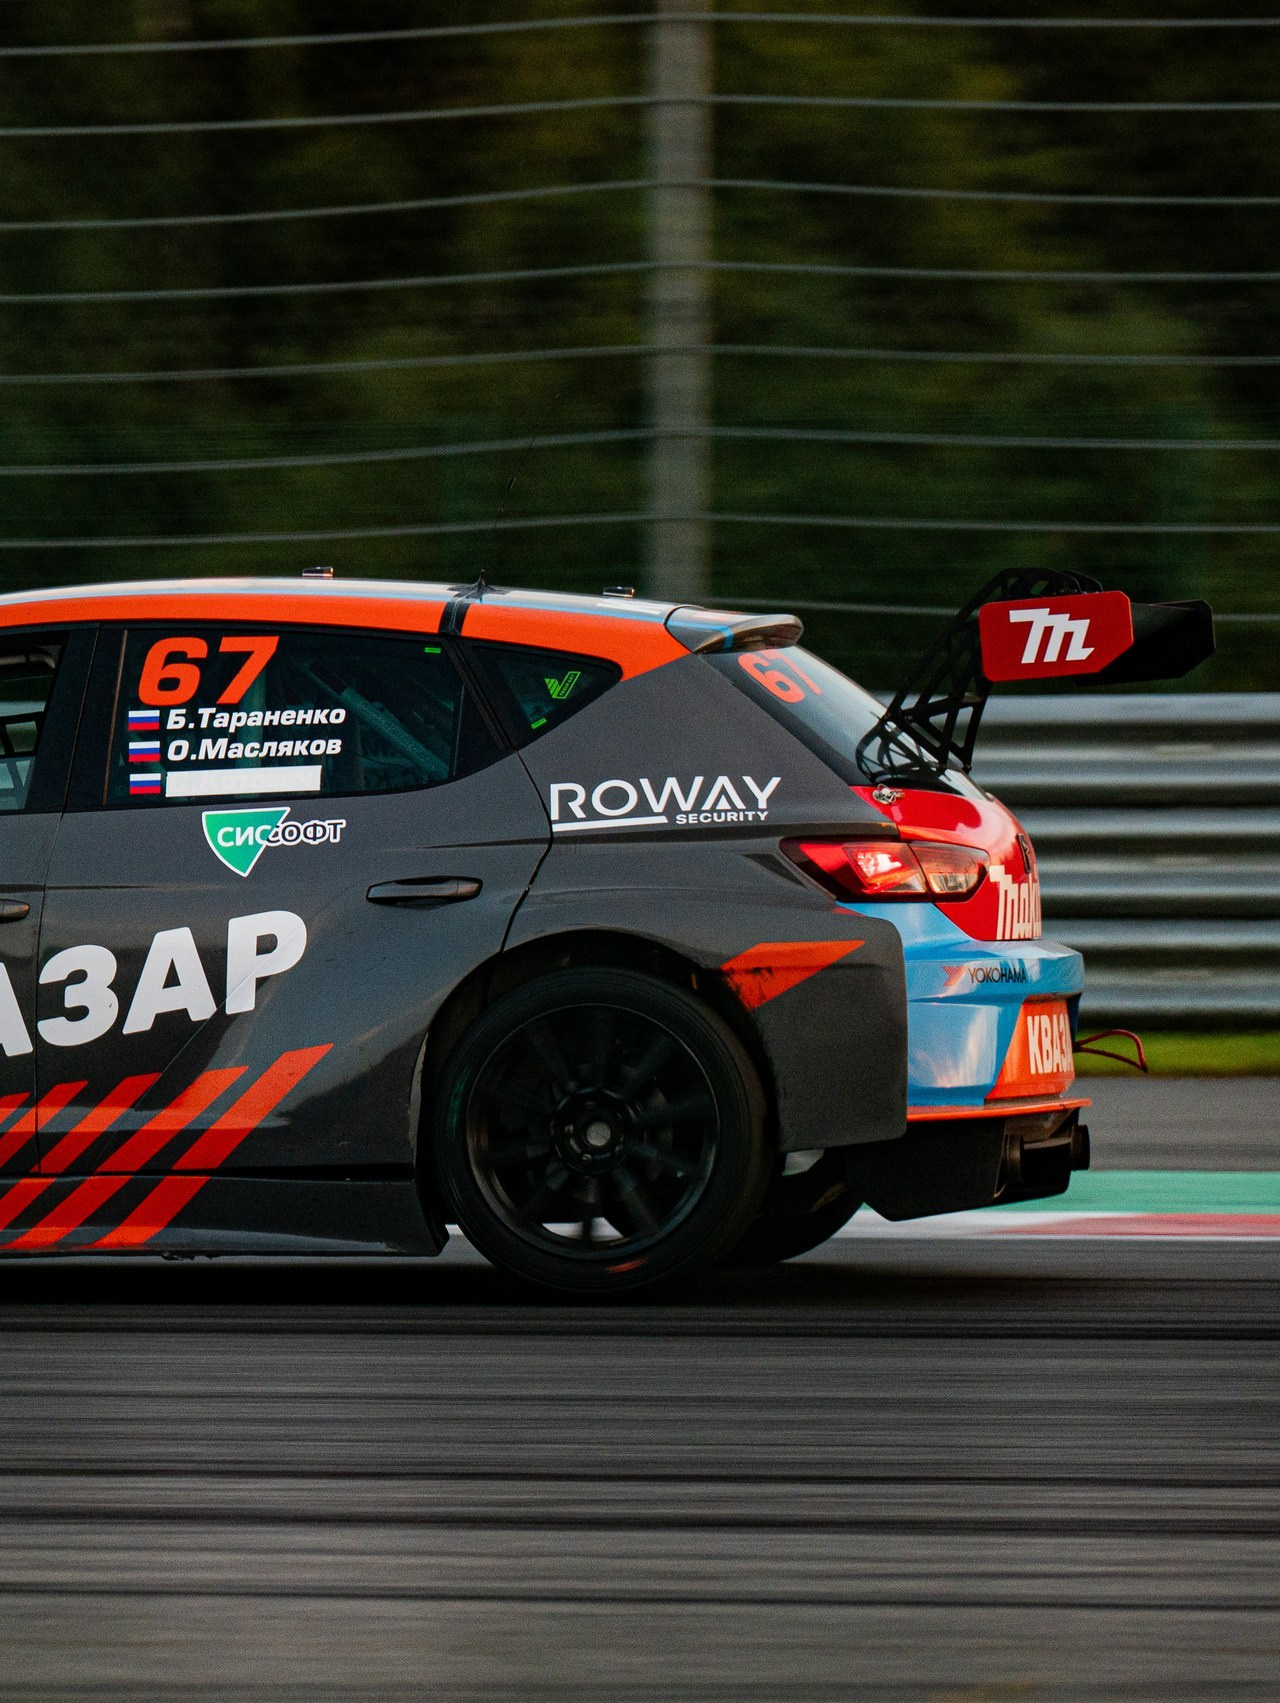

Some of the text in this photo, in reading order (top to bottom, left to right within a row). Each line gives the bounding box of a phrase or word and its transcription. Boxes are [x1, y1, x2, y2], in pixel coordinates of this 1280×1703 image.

[138, 636, 280, 706] 67
[738, 649, 824, 703] 67
[167, 707, 346, 733] Б.Тараненко
[167, 738, 342, 761] О.Масляков
[550, 776, 781, 820] ROWAY
[675, 811, 769, 825] SECURITY
[968, 967, 1027, 983] YOKOHAMA
